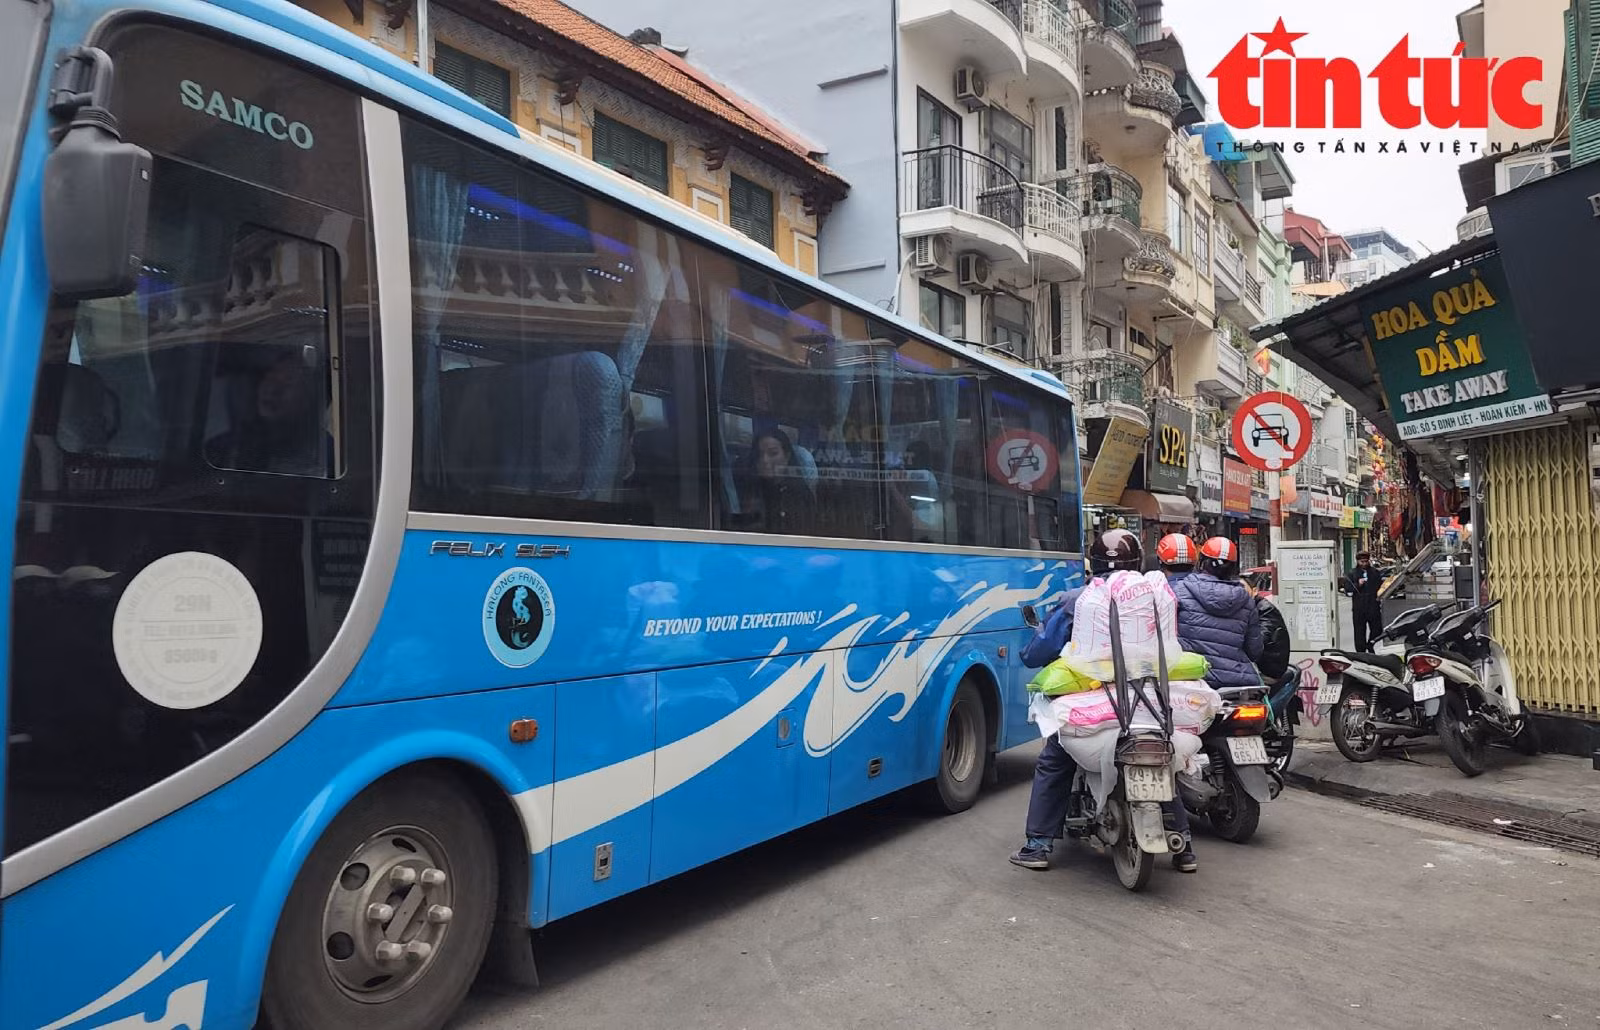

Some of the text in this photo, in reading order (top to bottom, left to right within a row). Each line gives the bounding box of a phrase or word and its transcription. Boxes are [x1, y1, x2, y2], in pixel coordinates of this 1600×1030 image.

[180, 80, 314, 150] SAMCO
[1371, 268, 1496, 340] HOA QUẢ
[1416, 330, 1484, 376] DẦM
[1401, 370, 1508, 413] TAKE AWAY
[1431, 421, 1437, 431] 5
[1534, 399, 1548, 412] HN
[1160, 423, 1188, 468] SPA
[430, 540, 506, 556] FELIX
[486, 572, 552, 619] HALONG FANTASEA
[643, 618, 702, 637] BEYOND
[705, 614, 739, 632] YOUR
[740, 610, 816, 630] EXPECTATIONS
